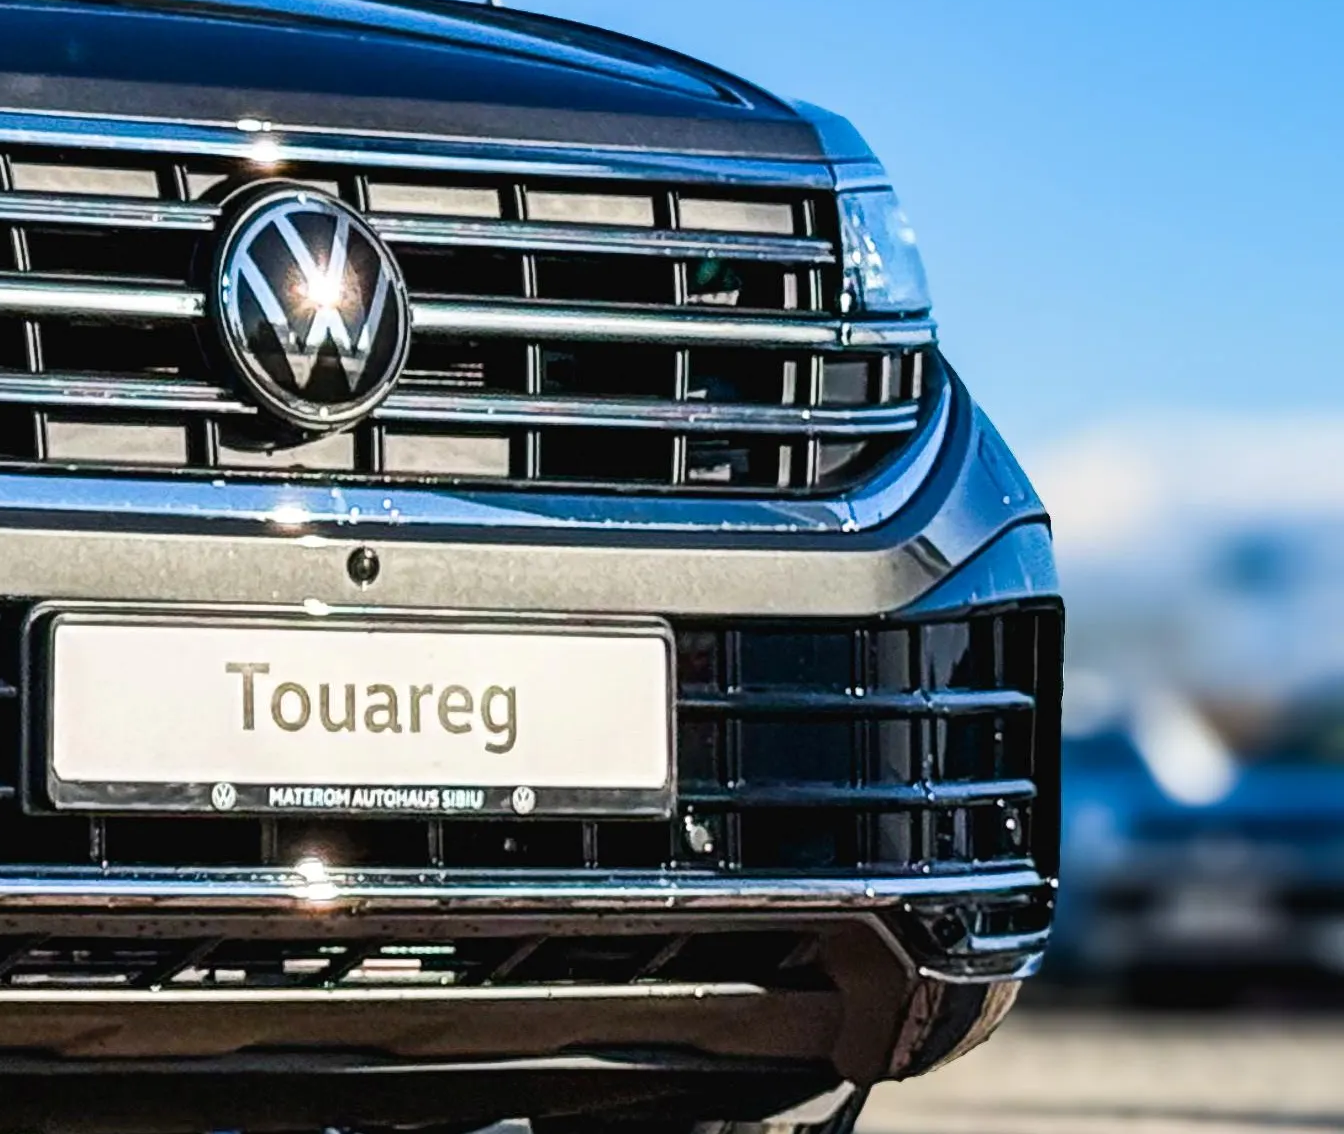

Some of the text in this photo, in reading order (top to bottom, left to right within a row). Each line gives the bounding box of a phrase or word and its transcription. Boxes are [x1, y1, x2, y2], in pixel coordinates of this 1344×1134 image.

[225, 662, 517, 754] Touareg
[268, 786, 484, 810] MATEROM AUTOHAUS SIBIU
